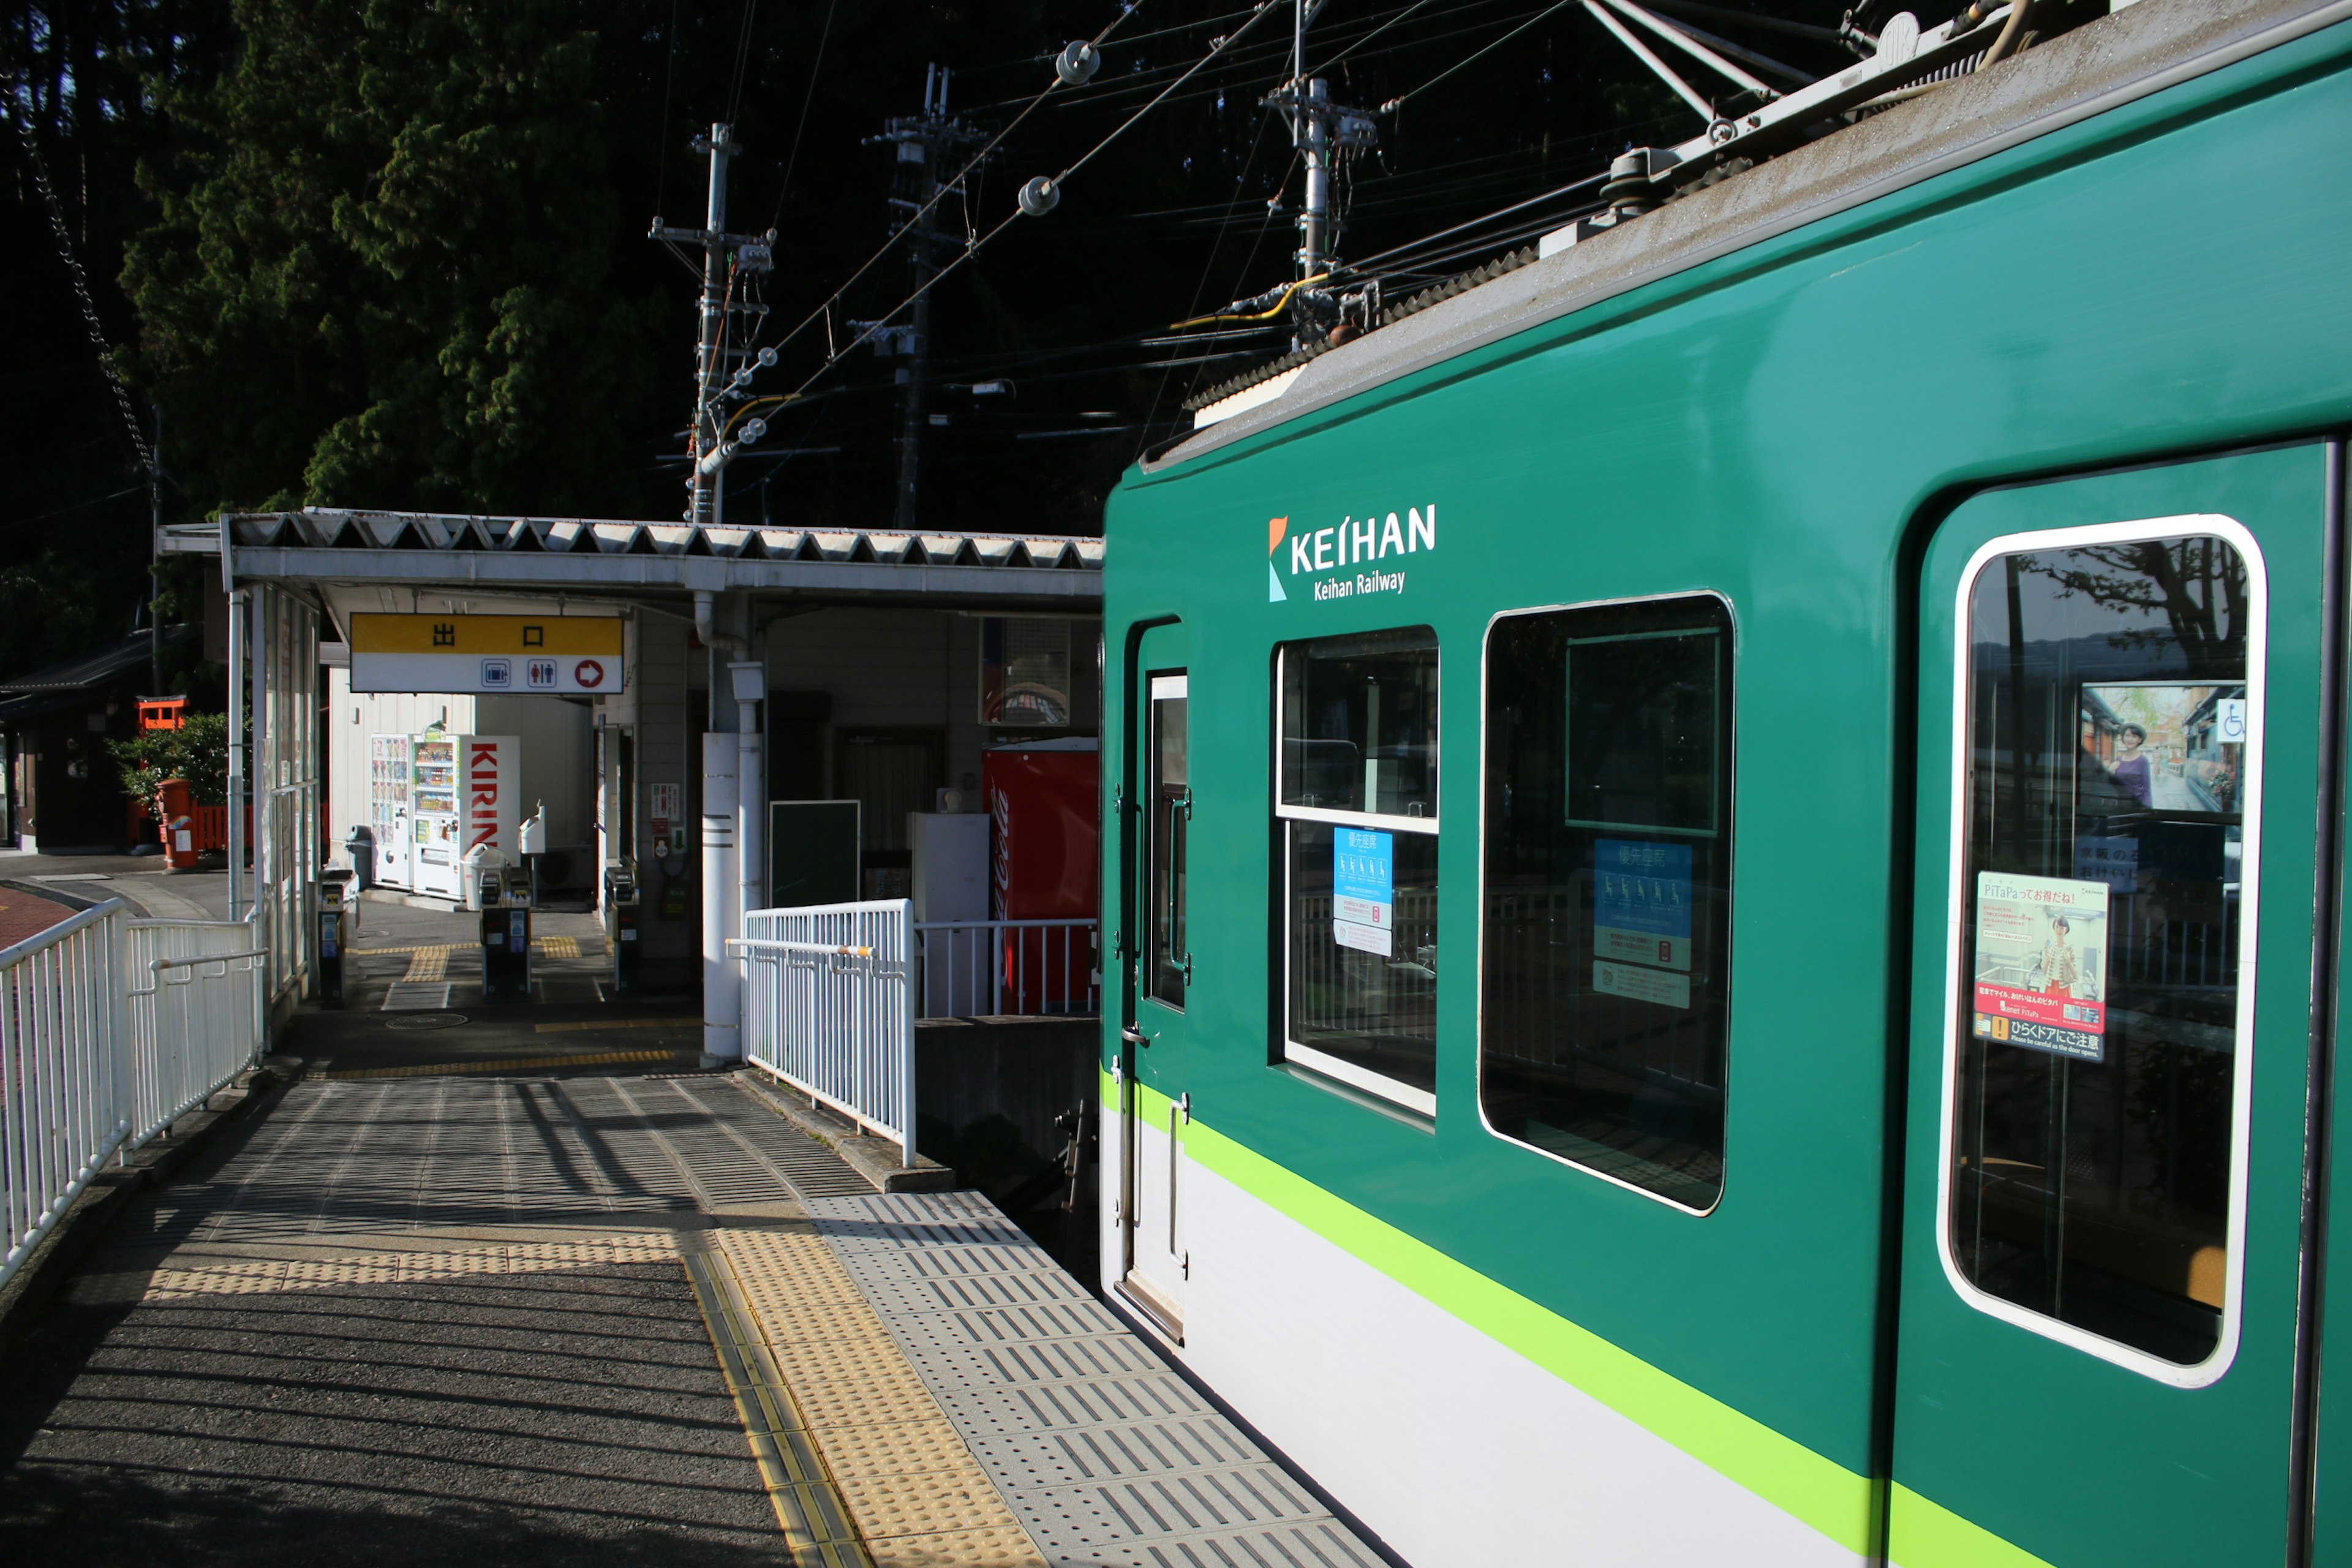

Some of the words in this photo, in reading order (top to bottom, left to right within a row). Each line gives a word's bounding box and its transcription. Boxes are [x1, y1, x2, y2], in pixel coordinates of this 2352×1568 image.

[718, 233, 725, 242] S
[1291, 503, 1436, 575] KEIHAN
[1314, 578, 1353, 601] Keihan
[1357, 570, 1406, 595] Railway
[471, 743, 498, 848] KIRIN
[1348, 831, 1378, 850] 優先座席
[1619, 845, 1666, 867] 優先座席
[2011, 1021, 2100, 1050] ひらくドアにご注意
[2011, 1035, 2027, 1044] Please
[2034, 1039, 2052, 1049] careful
[2068, 1046, 2081, 1054] door
[2081, 1049, 2098, 1058] opens.
